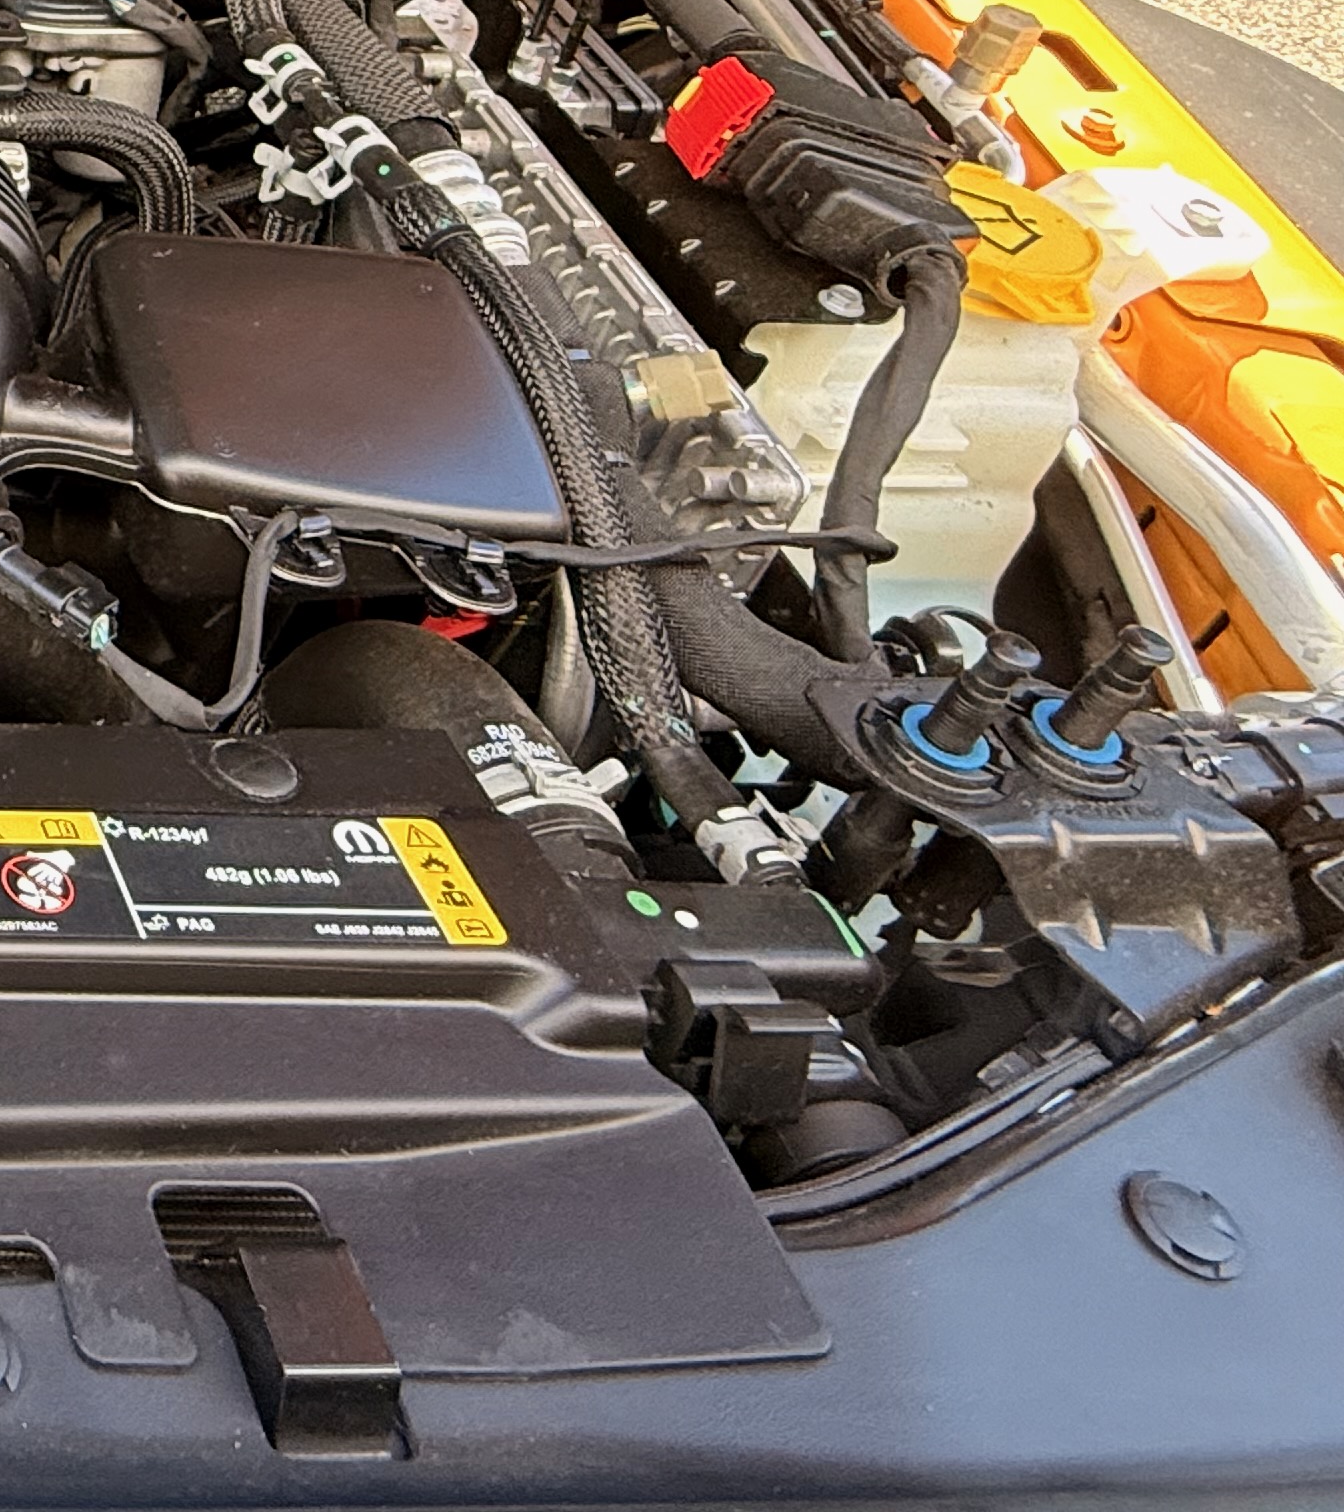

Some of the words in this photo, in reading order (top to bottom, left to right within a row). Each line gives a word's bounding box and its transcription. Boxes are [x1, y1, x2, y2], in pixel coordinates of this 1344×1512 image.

[484, 724, 526, 740] RAD
[301, 868, 341, 888] lbs)
[176, 916, 216, 932] PAG
